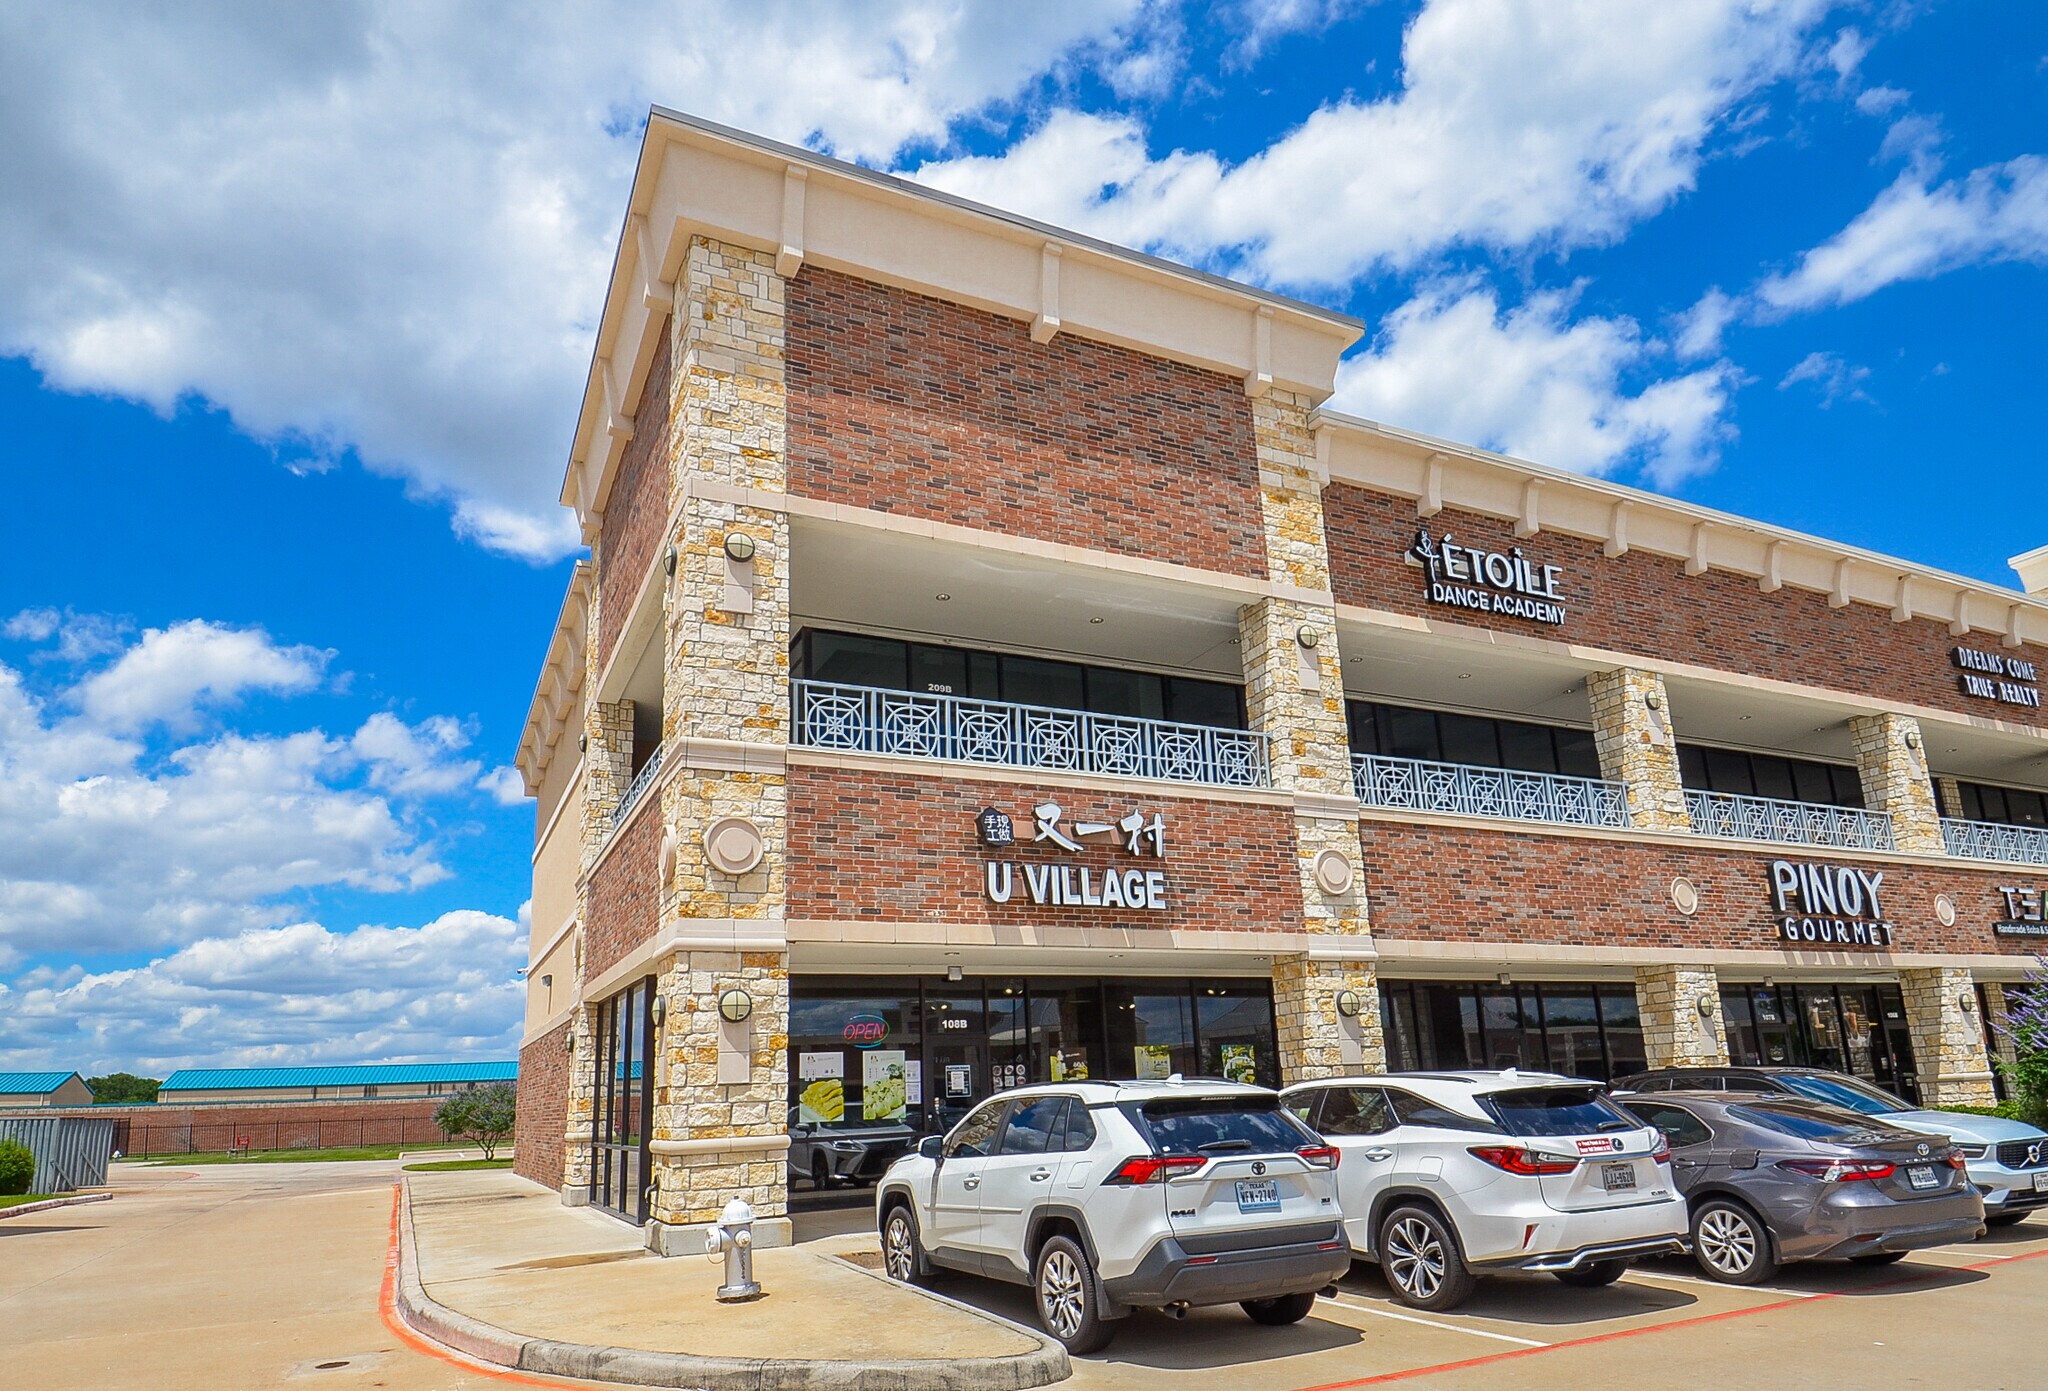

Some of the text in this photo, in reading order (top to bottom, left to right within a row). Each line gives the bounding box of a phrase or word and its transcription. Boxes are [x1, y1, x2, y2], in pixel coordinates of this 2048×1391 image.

[1432, 583, 1566, 625] DANCE ACADEMY
[1957, 646, 2037, 681] DREAMS COME
[927, 683, 953, 693] 209B
[1963, 674, 2040, 707] TRUE REALTY
[1034, 803, 1166, 858] 又一村
[987, 861, 1167, 910] U VILLAGE
[1772, 860, 1884, 919] PINOY
[1785, 916, 1893, 946] GOURMET
[843, 1023, 886, 1040] OPEN
[942, 1020, 968, 1029] 108B
